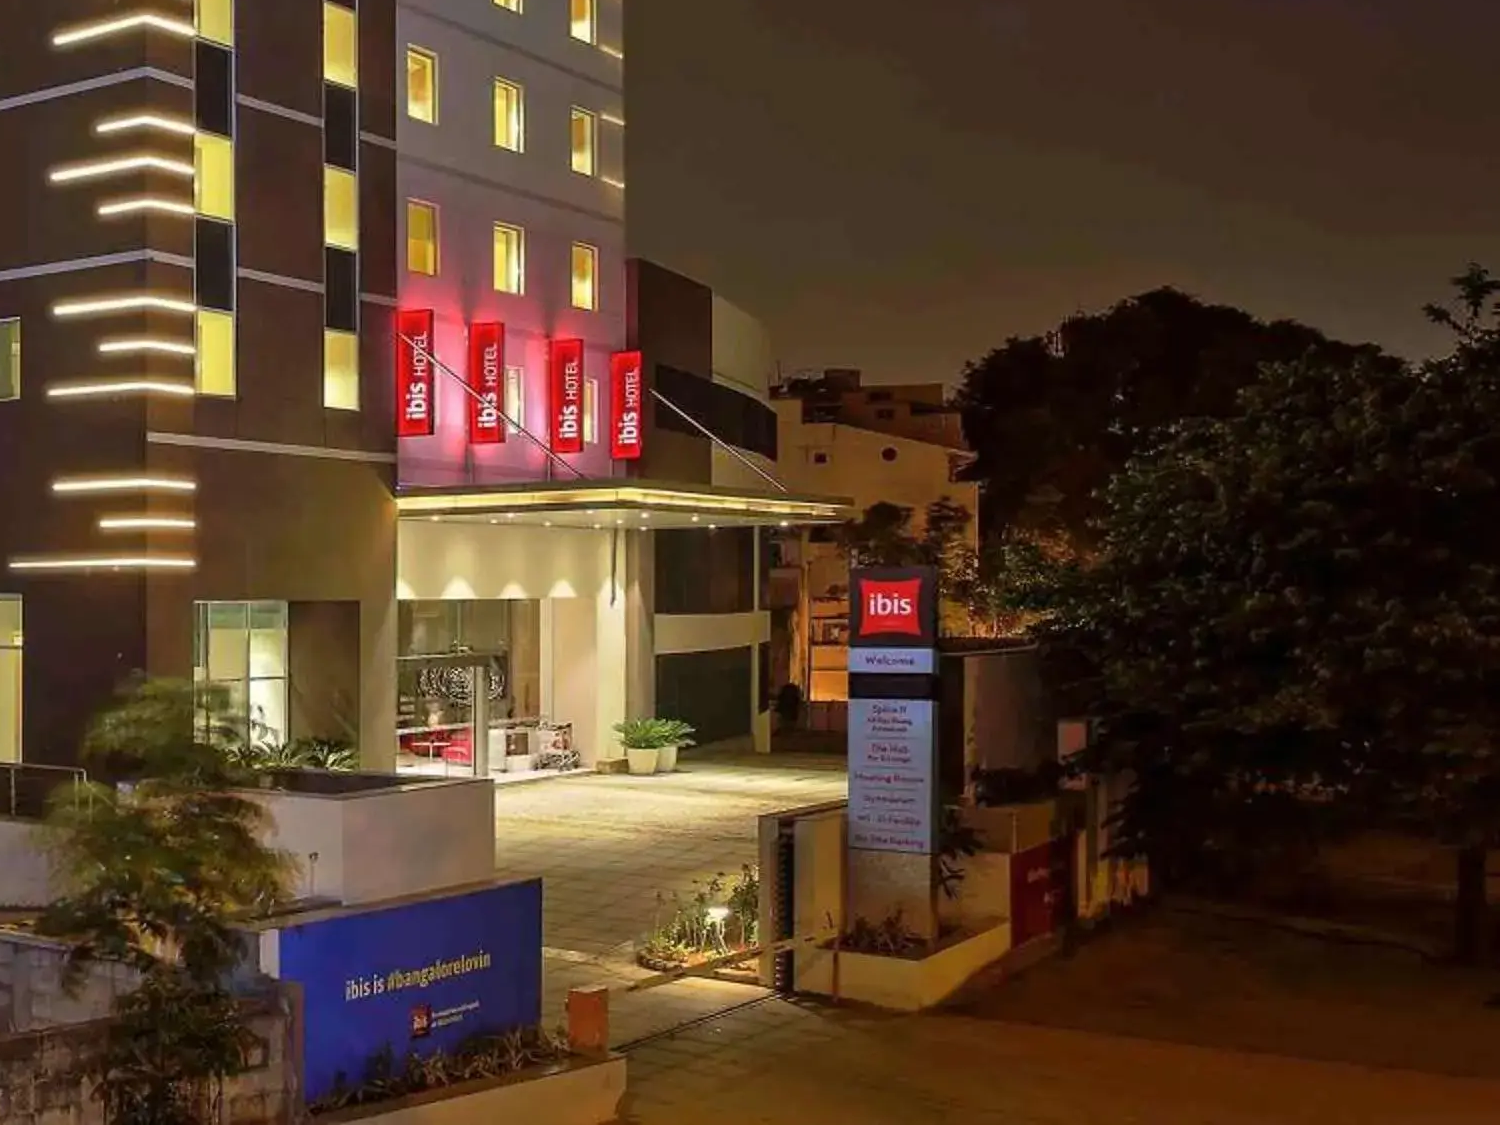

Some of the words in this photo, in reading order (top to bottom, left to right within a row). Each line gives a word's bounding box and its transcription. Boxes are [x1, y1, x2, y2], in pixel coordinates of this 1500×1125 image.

[413, 331, 428, 376] HOTEL
[486, 343, 499, 387] HOTEL
[566, 358, 579, 400] HOTEL
[626, 368, 640, 408] HOTEL
[406, 381, 426, 421] ibis
[478, 392, 497, 429] ibis
[559, 403, 578, 439] ibis
[619, 410, 638, 445] ibis
[869, 592, 912, 616] ibis
[865, 655, 915, 666] Welcome
[345, 976, 371, 1002] ibis
[373, 974, 385, 995] is
[387, 949, 491, 991] #bangalorelovin
